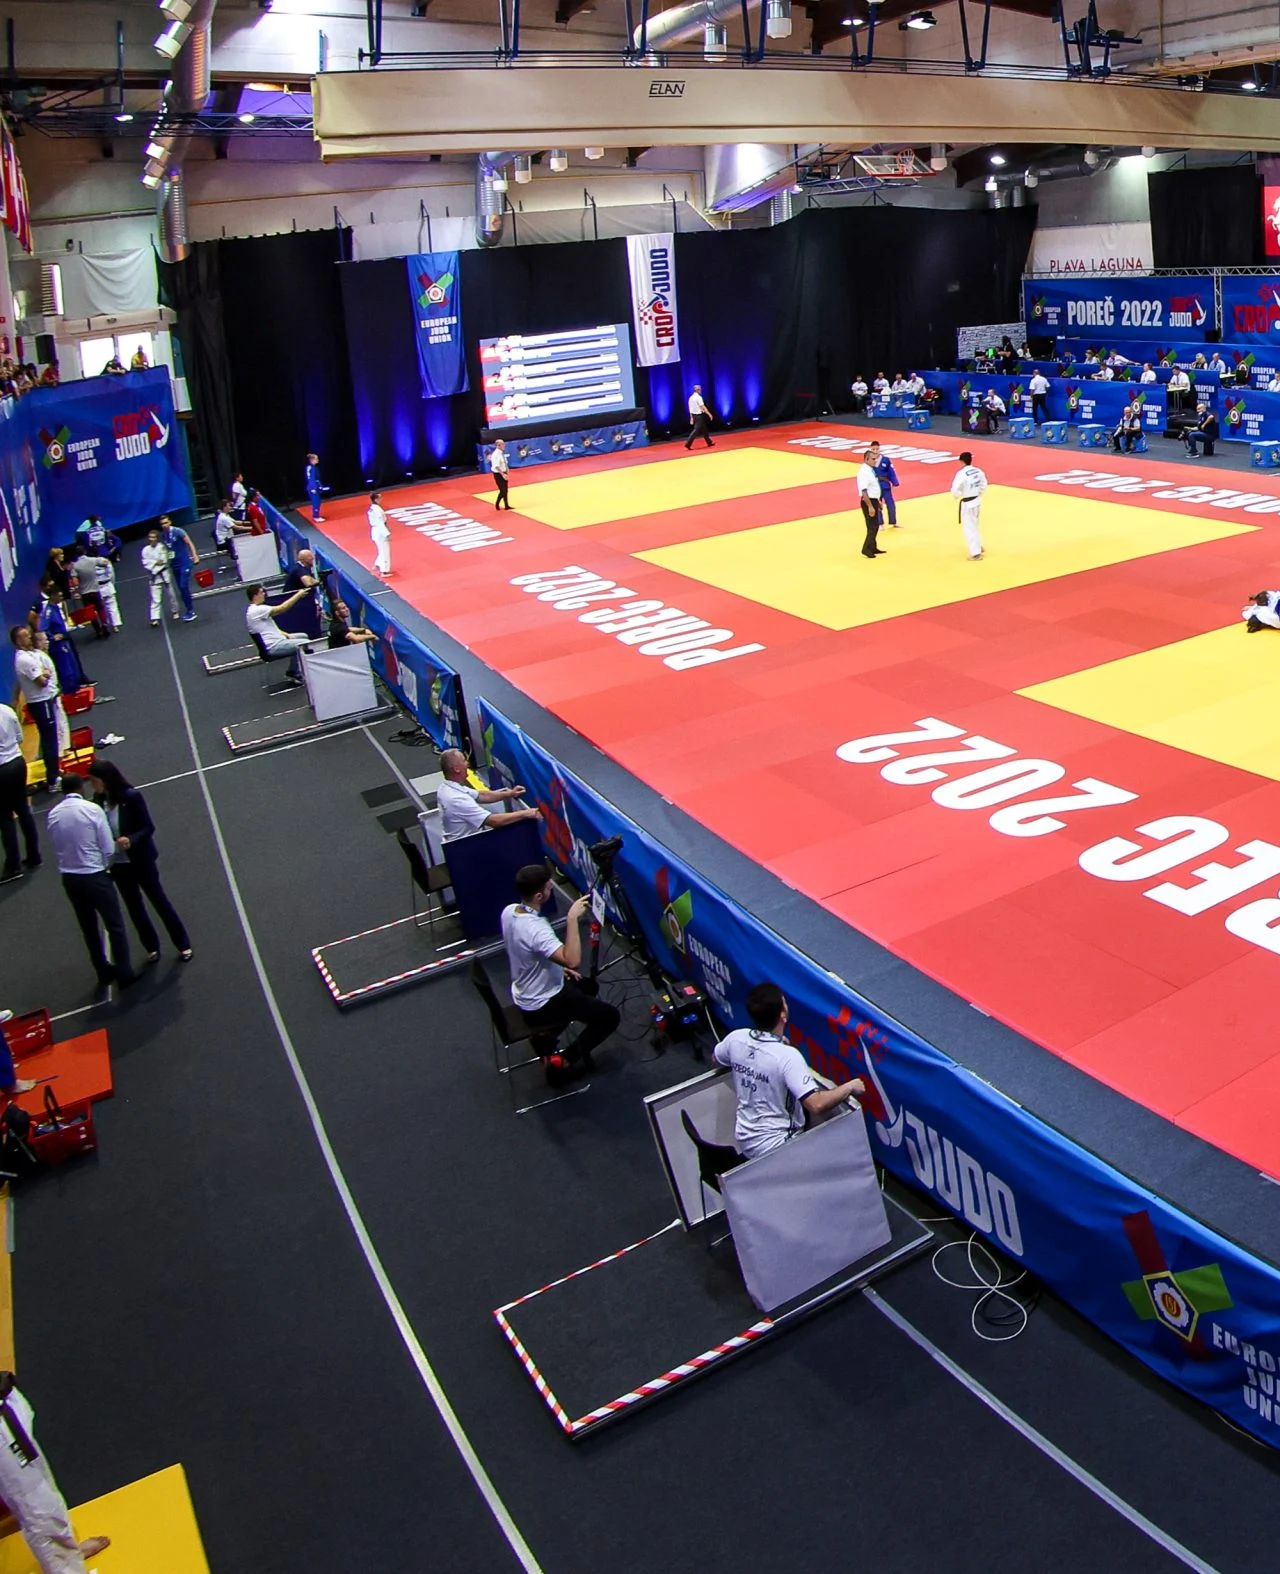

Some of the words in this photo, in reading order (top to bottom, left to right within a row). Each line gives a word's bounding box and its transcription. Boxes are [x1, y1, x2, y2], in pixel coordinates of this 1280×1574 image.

[649, 83, 685, 95] ELAN
[650, 248, 671, 292] JUDO
[1050, 260, 1086, 272] PLAVA
[1092, 257, 1143, 275] LAGUNA
[1067, 296, 1114, 326] POREČ
[1120, 300, 1163, 327] 2022
[1169, 312, 1192, 327] JUDO
[655, 315, 675, 347] CRO
[115, 432, 150, 461] JUDO
[1035, 468, 1147, 494] 2022
[509, 565, 638, 610] 2022
[577, 600, 767, 671] POREC
[836, 717, 1140, 838] 2022
[687, 933, 732, 985] EUROPEAN
[905, 1110, 1024, 1257] JUDO
